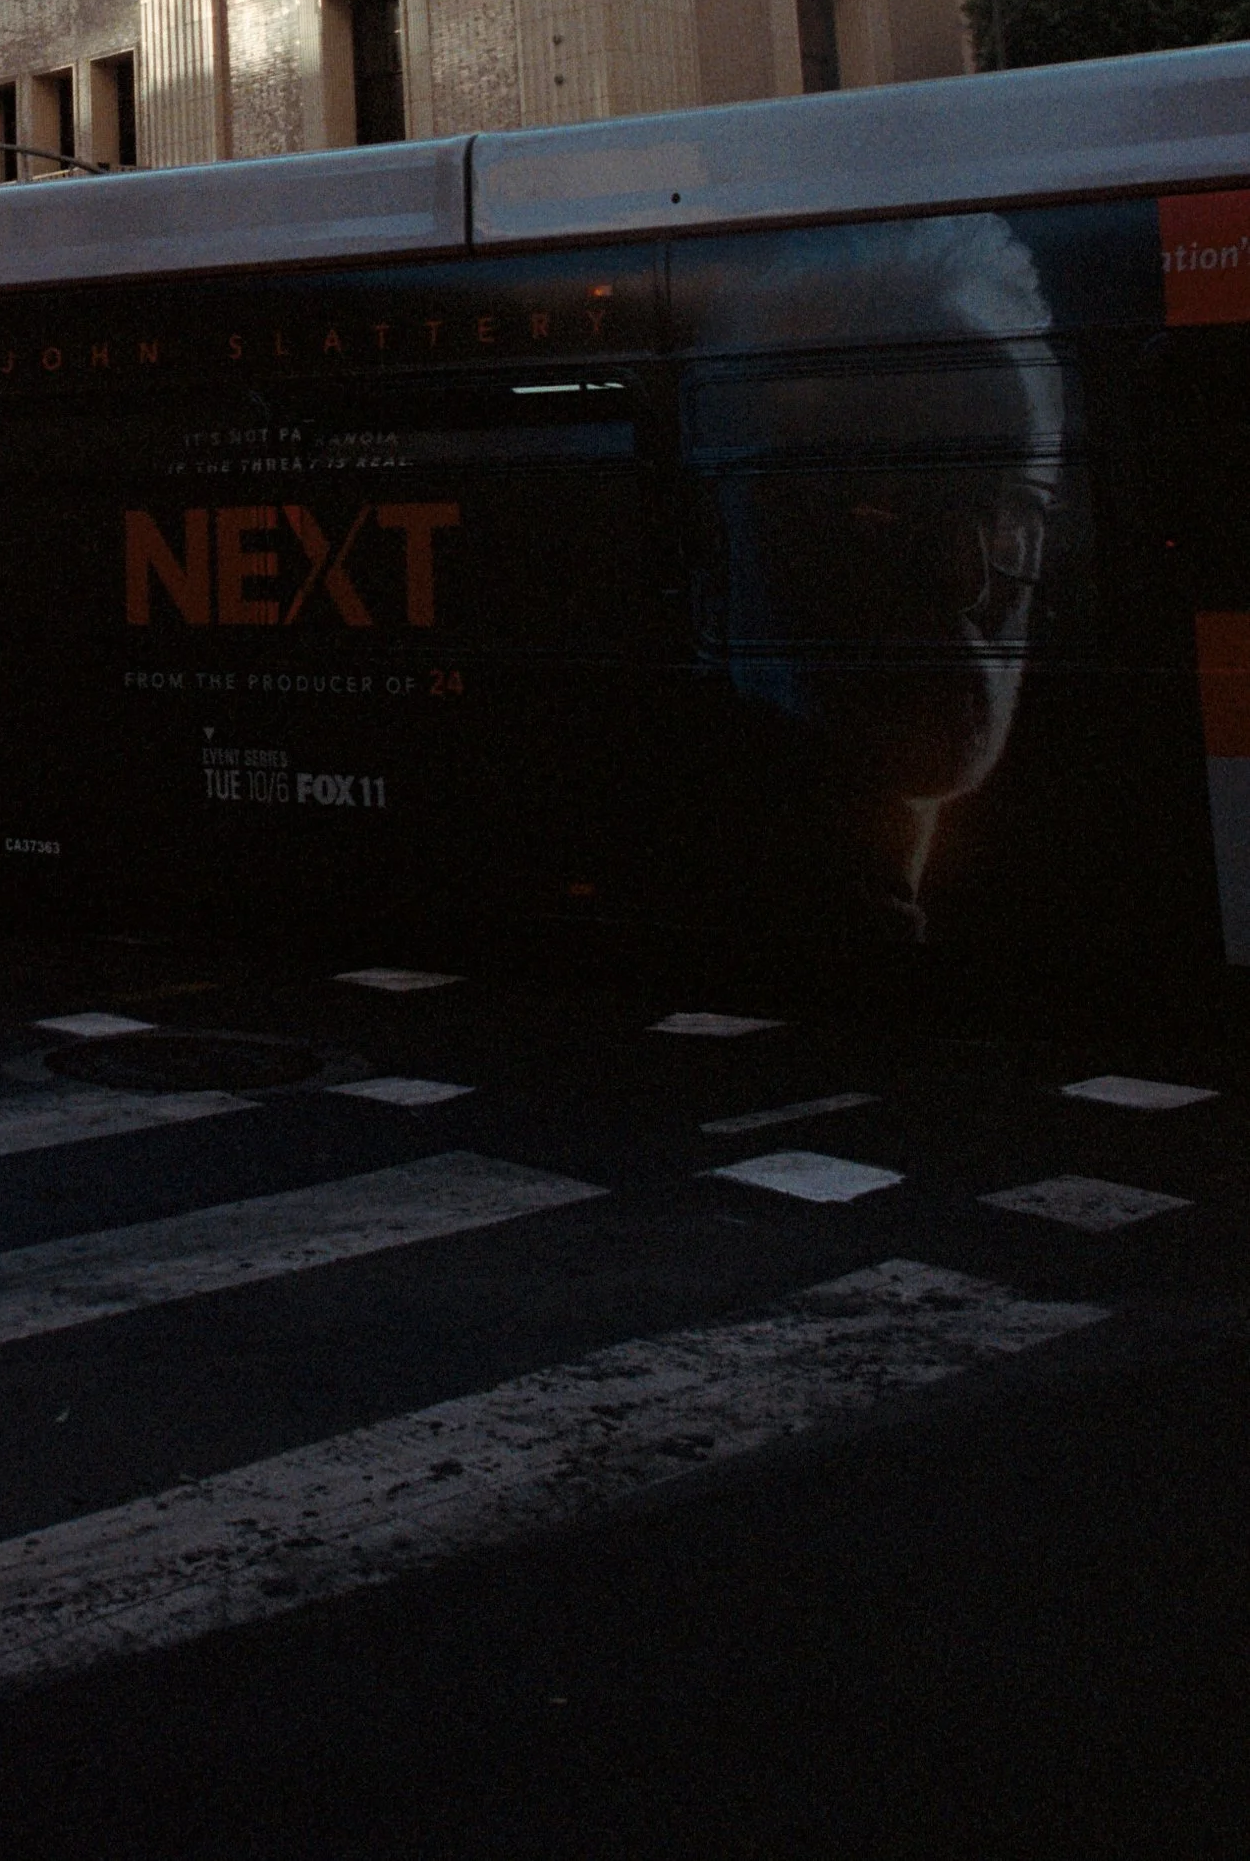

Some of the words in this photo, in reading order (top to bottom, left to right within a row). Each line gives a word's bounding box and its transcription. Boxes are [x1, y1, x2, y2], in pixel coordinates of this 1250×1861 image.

[2, 342, 161, 375] JOHN
[228, 310, 607, 360] SLATTERY
[229, 428, 268, 444] NOT
[195, 459, 230, 475] THE
[124, 501, 461, 626] NEXT
[124, 670, 184, 690] FROM
[196, 672, 236, 690] THE
[248, 674, 374, 694] PRODUCER
[385, 676, 416, 695] OF
[429, 669, 465, 696] 24
[202, 747, 240, 766] EVENT
[244, 749, 288, 768] SERIES
[204, 768, 243, 802] TUE
[246, 770, 290, 803] 10/6
[296, 772, 356, 807] FOX
[358, 775, 387, 809] 11
